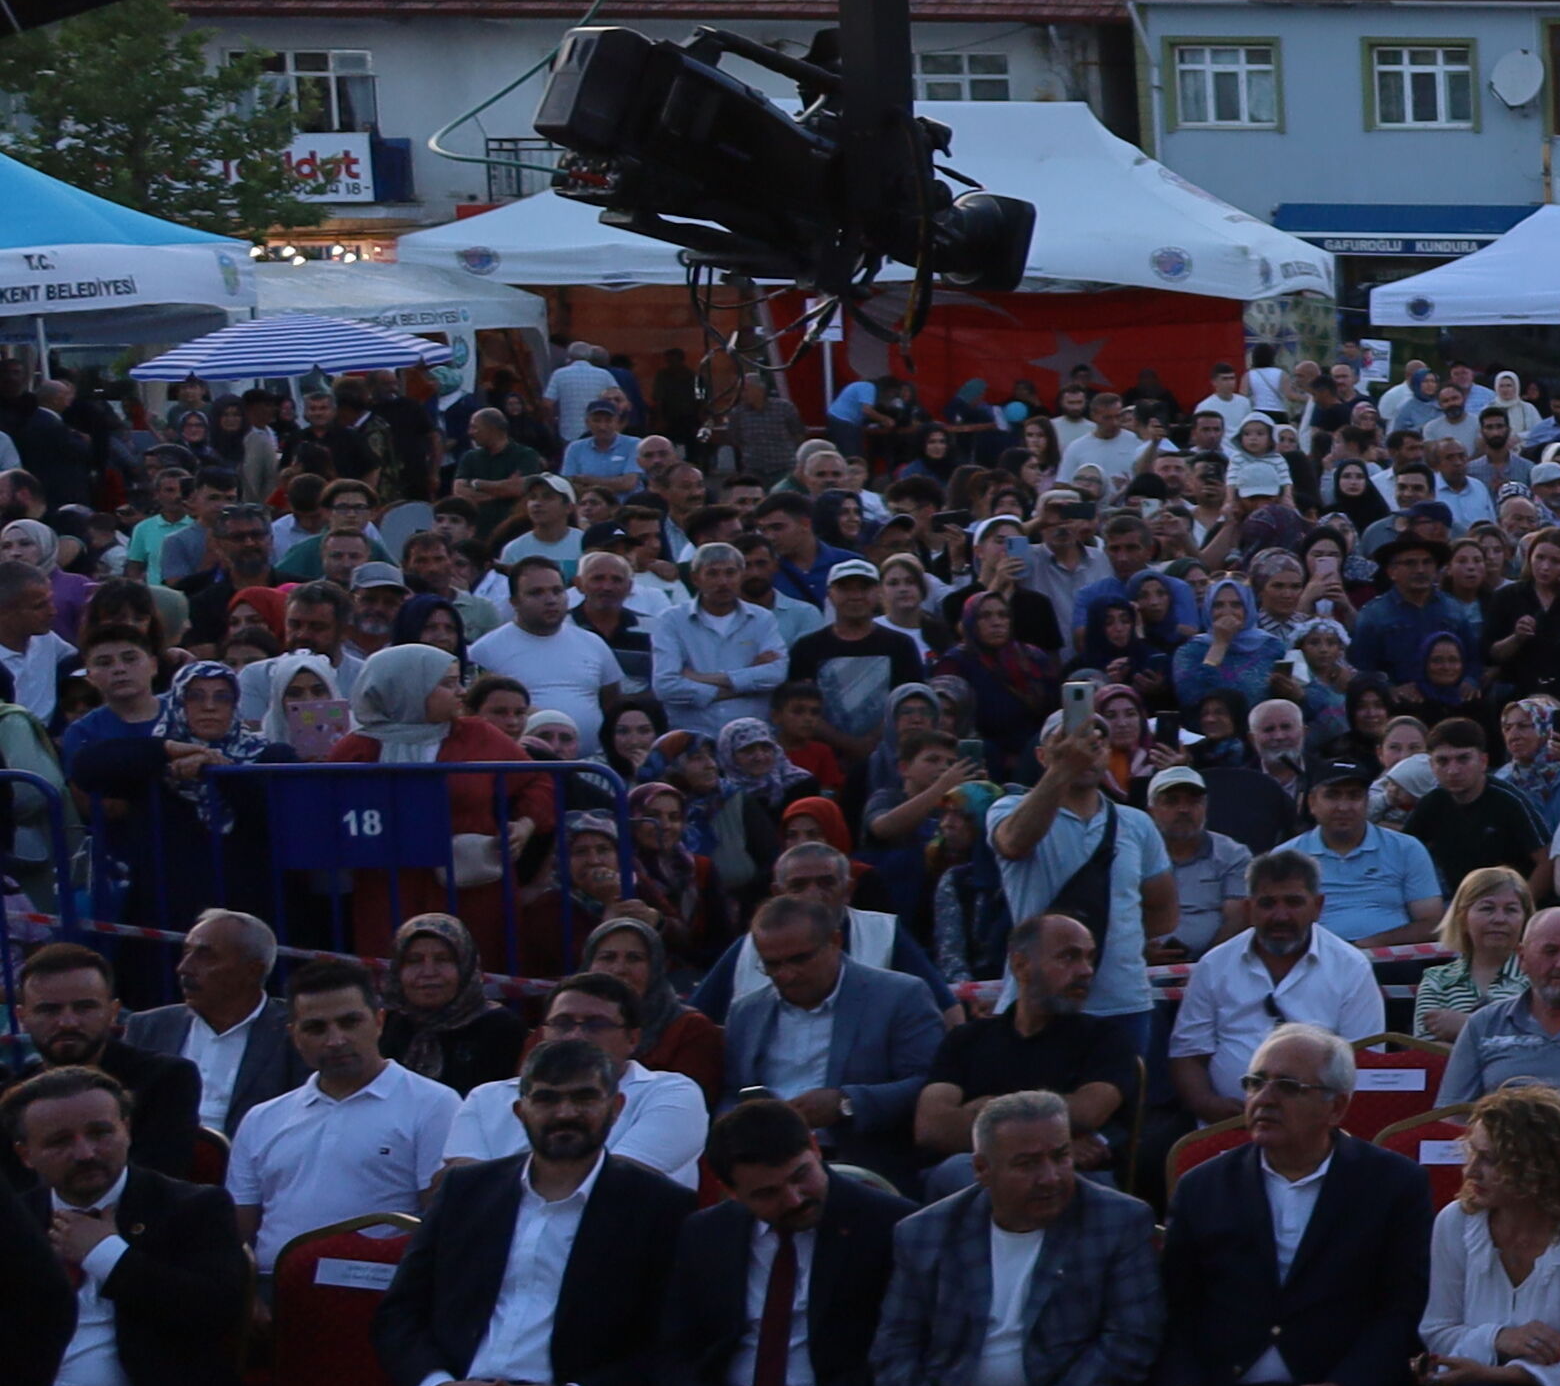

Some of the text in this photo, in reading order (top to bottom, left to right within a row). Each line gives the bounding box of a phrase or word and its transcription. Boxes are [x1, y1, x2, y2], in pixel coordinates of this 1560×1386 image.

[1415, 239, 1479, 253] KUNDURA
[23, 253, 57, 271] T.C.
[46, 274, 139, 302] BELEDİYESİ
[343, 809, 382, 836] 18
